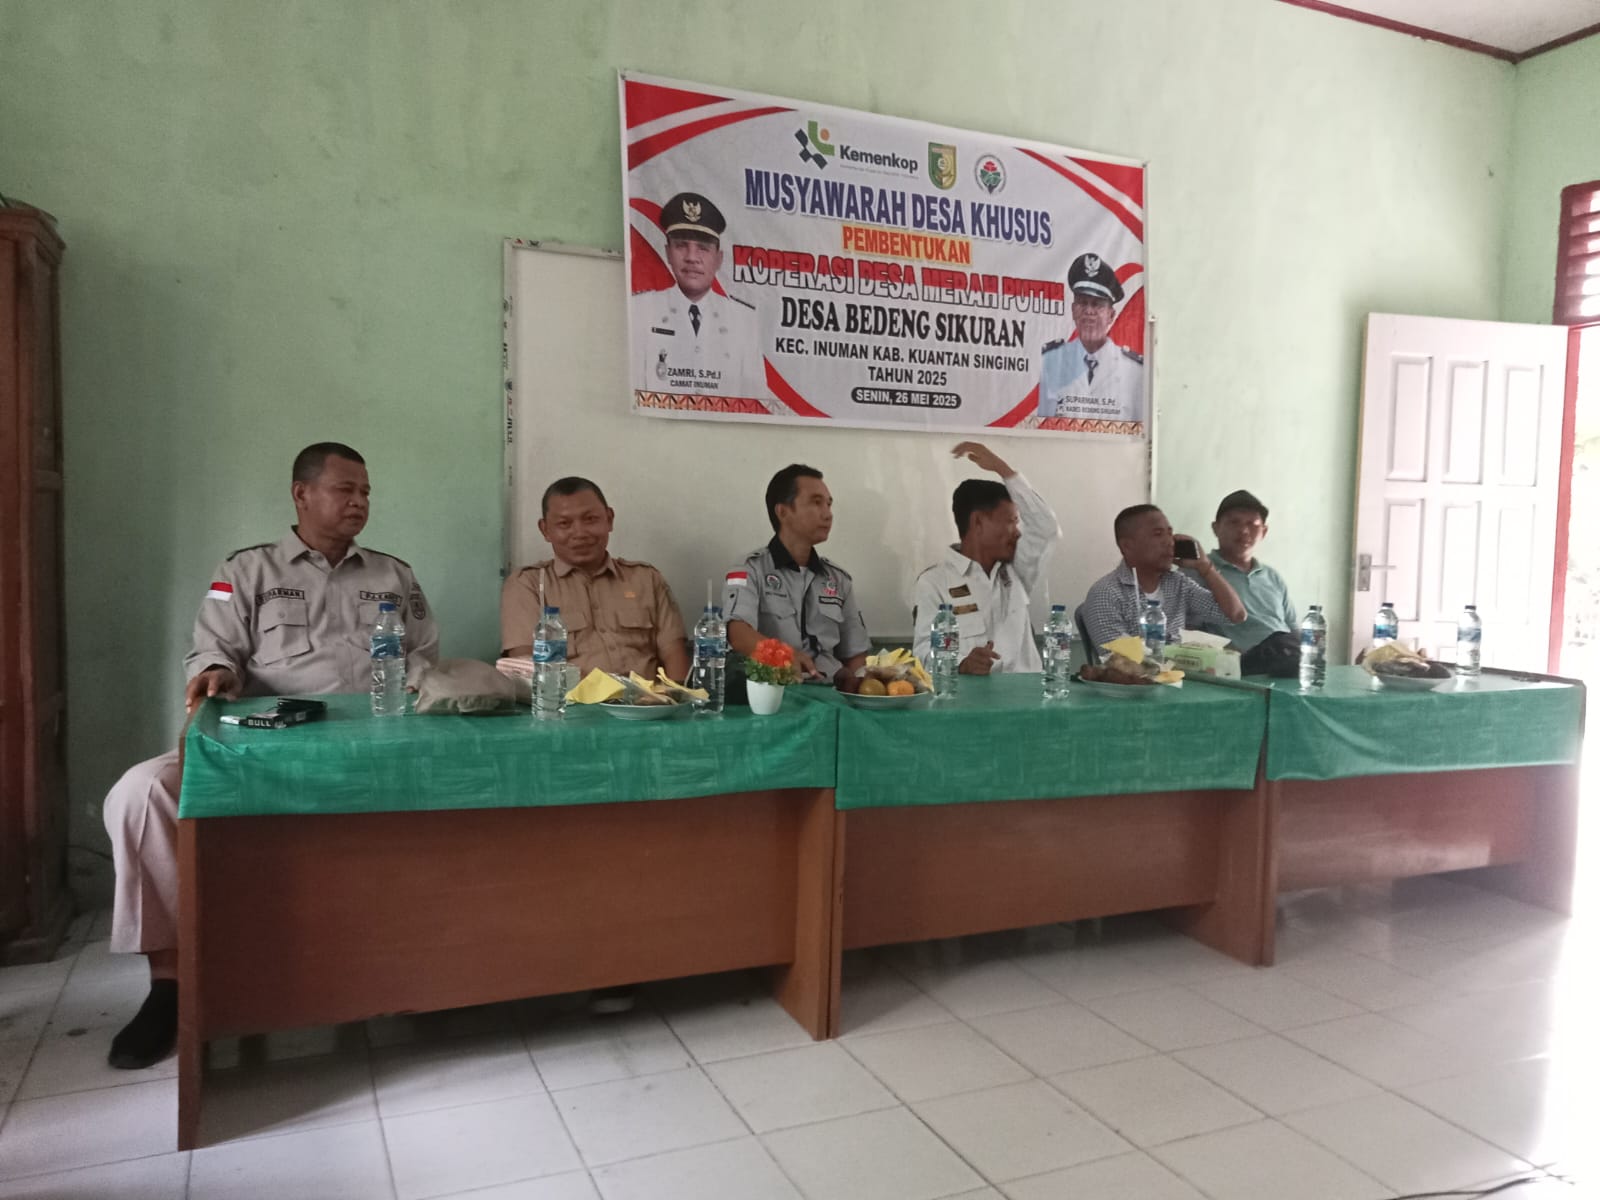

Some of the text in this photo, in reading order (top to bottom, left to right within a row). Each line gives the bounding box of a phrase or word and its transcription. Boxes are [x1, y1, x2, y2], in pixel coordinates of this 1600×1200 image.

[839, 144, 919, 174] Kemenkop
[744, 167, 1052, 246] MUSYAWARAH DESA KHUSUS
[842, 225, 971, 265] PEMBENTUKAN
[732, 244, 1065, 316] KOPERASI DESA MERAH PUTIH
[780, 296, 1026, 348] DESA BEDENG SIKURAN
[775, 337, 1030, 373] KEC. INUMAN KAB. KUANTAN SINGINGI
[667, 367, 697, 379] ZAMRI,
[670, 380, 693, 388] CAMAT
[867, 365, 948, 387] TAHUN 2025
[855, 388, 958, 408] SENIN, 26 MEI 2025
[247, 718, 272, 728] BULL
